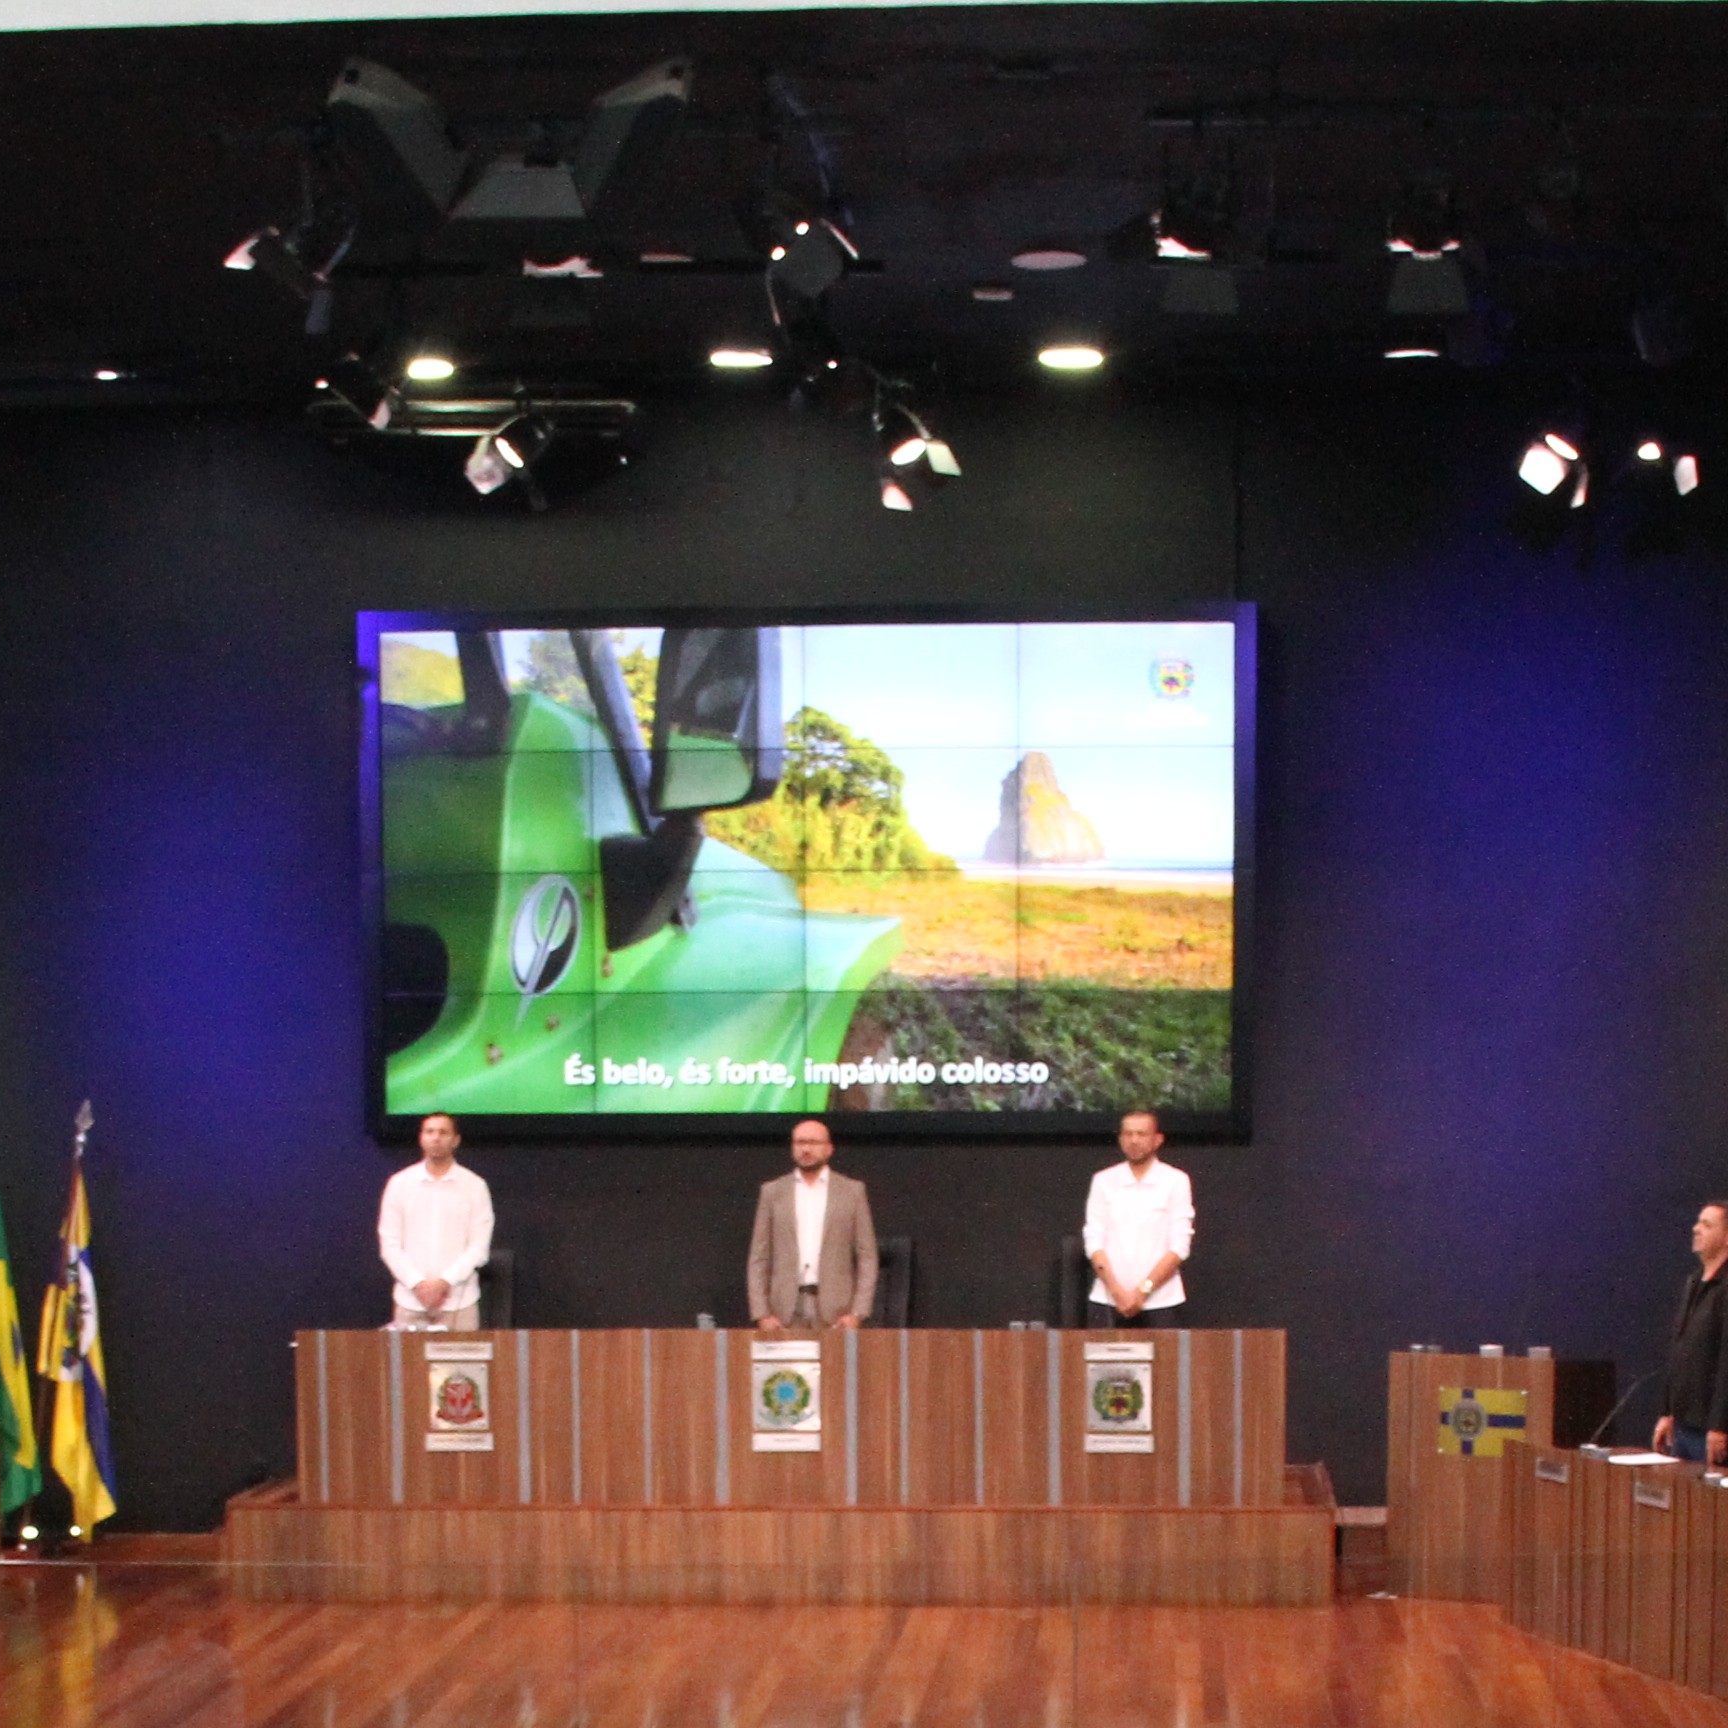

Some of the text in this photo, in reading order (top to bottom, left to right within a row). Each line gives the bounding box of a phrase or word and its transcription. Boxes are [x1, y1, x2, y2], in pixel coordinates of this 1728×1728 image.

[564, 1053, 1049, 1091] És belo, és forte, impávido colosso
